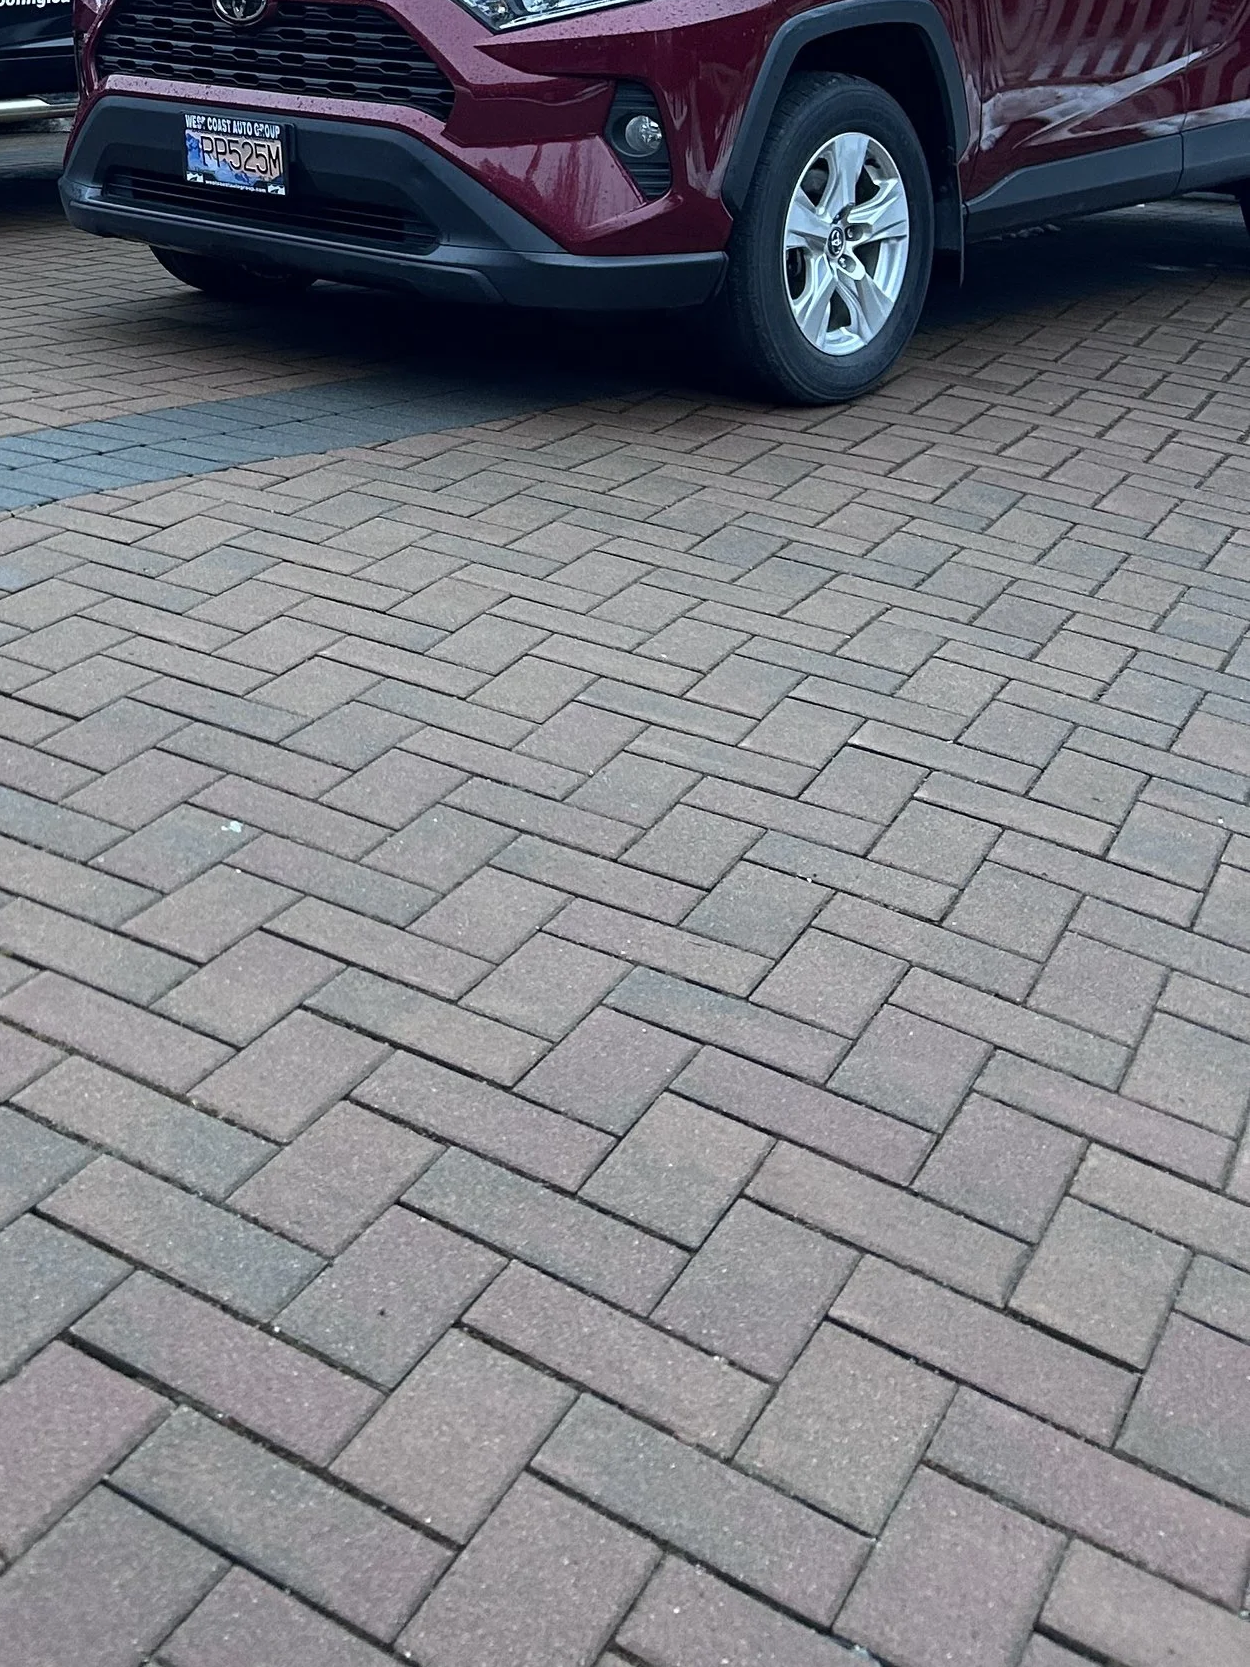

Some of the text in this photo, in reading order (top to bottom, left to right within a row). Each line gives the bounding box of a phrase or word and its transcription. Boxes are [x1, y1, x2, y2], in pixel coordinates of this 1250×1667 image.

[207, 117, 231, 133] COAST
[232, 120, 253, 135] AUTO
[253, 122, 280, 138] GROUP
